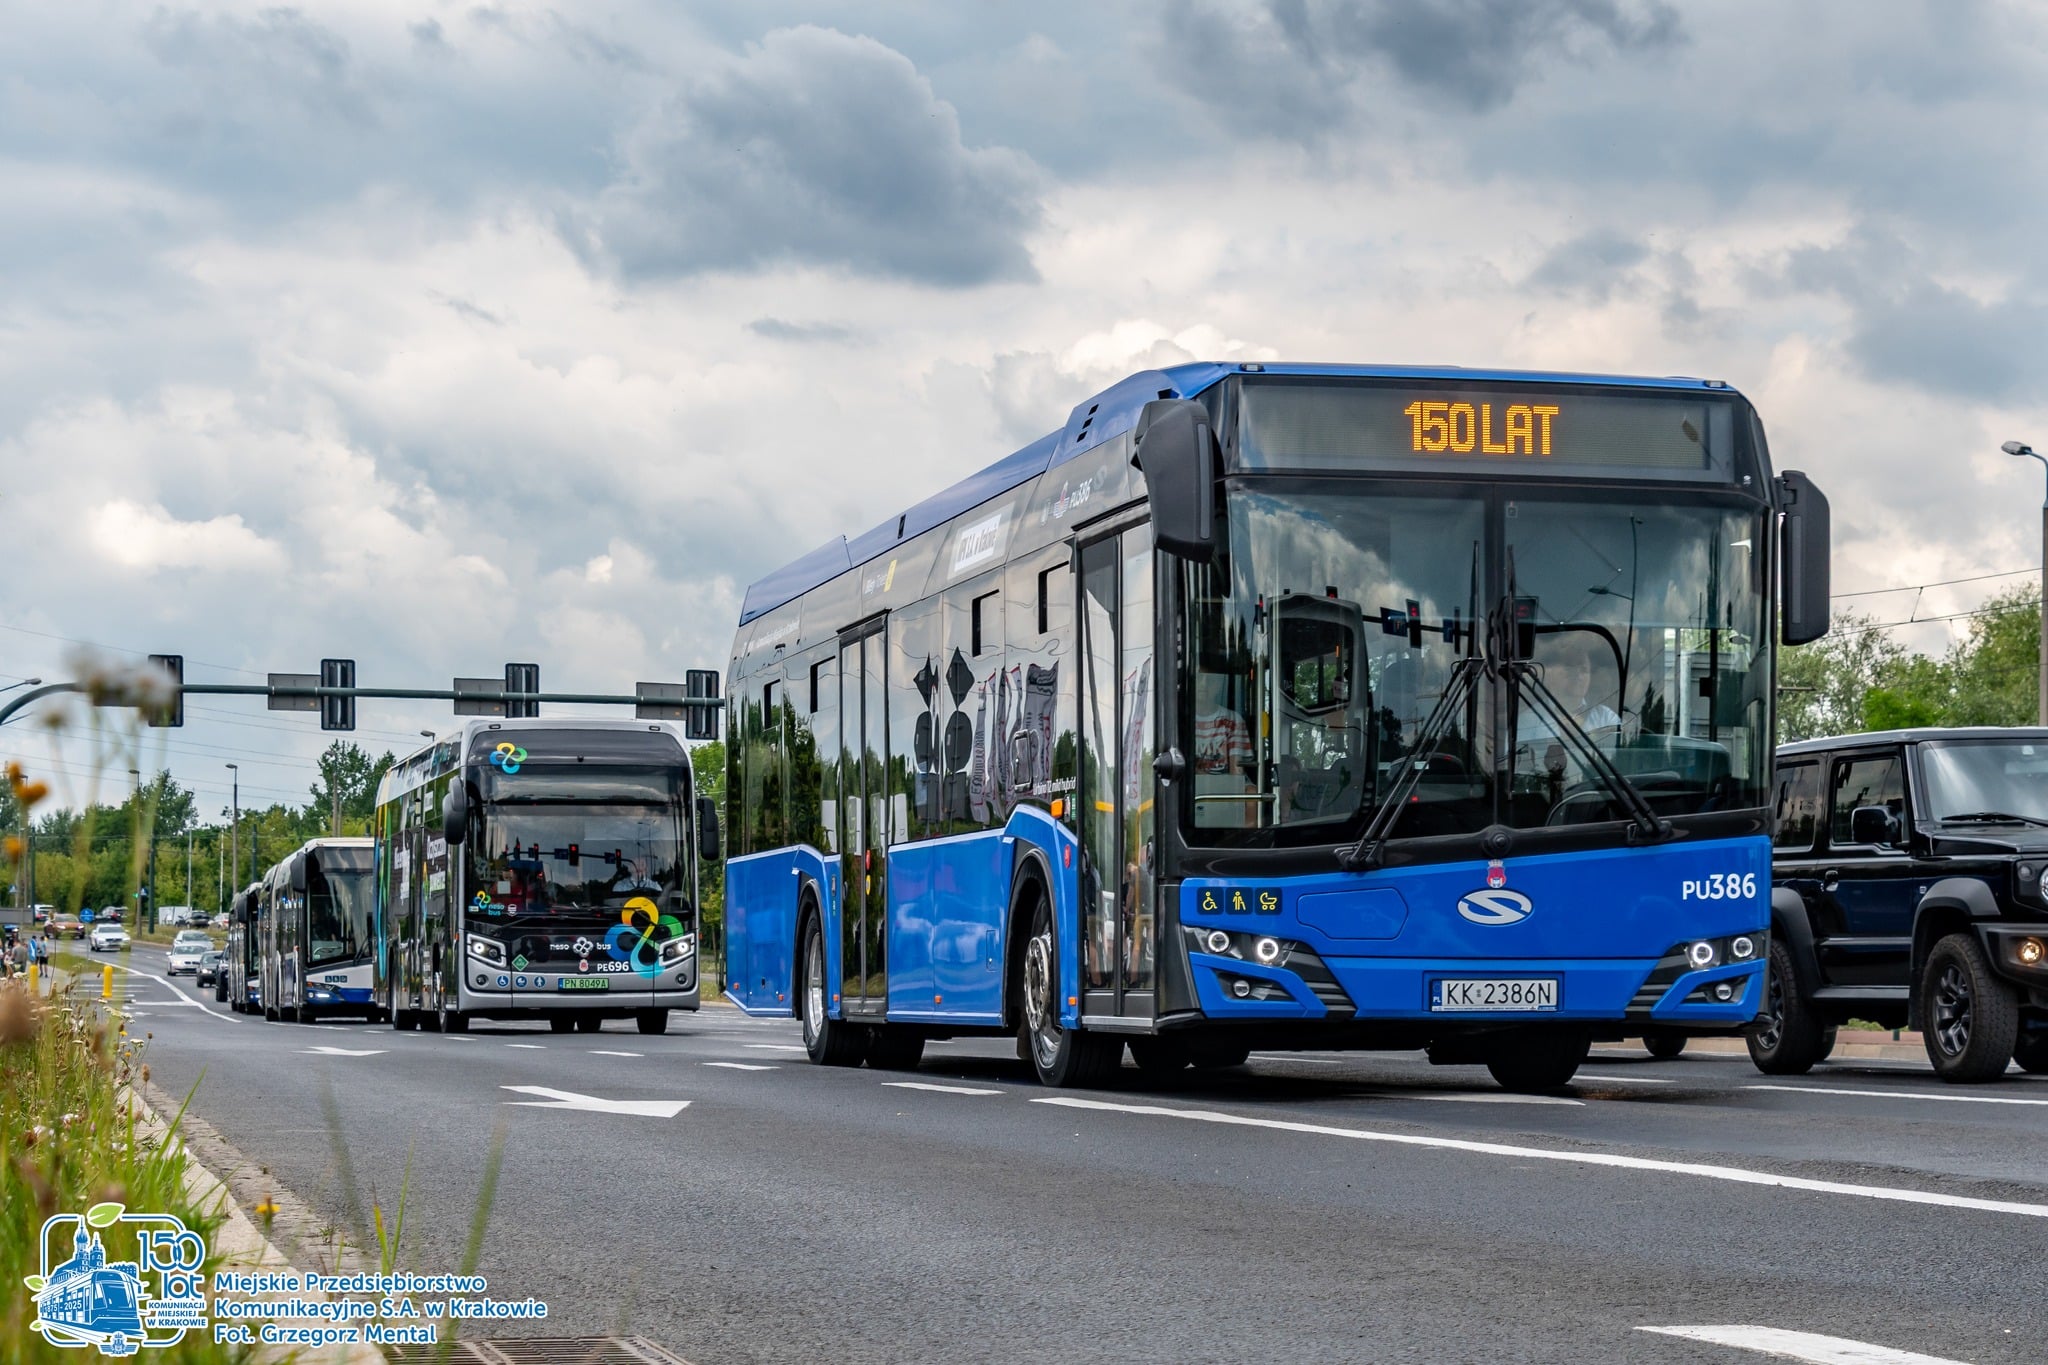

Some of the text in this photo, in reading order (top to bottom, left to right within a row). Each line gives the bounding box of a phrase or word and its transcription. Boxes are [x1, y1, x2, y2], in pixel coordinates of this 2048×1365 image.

[1404, 401, 1559, 455] 150 LAT
[1682, 872, 1757, 900] PU386
[596, 942, 612, 950] bus
[597, 961, 630, 972] PE696
[564, 978, 607, 988] PN 8049A
[1447, 983, 1551, 1005] KK 2386N
